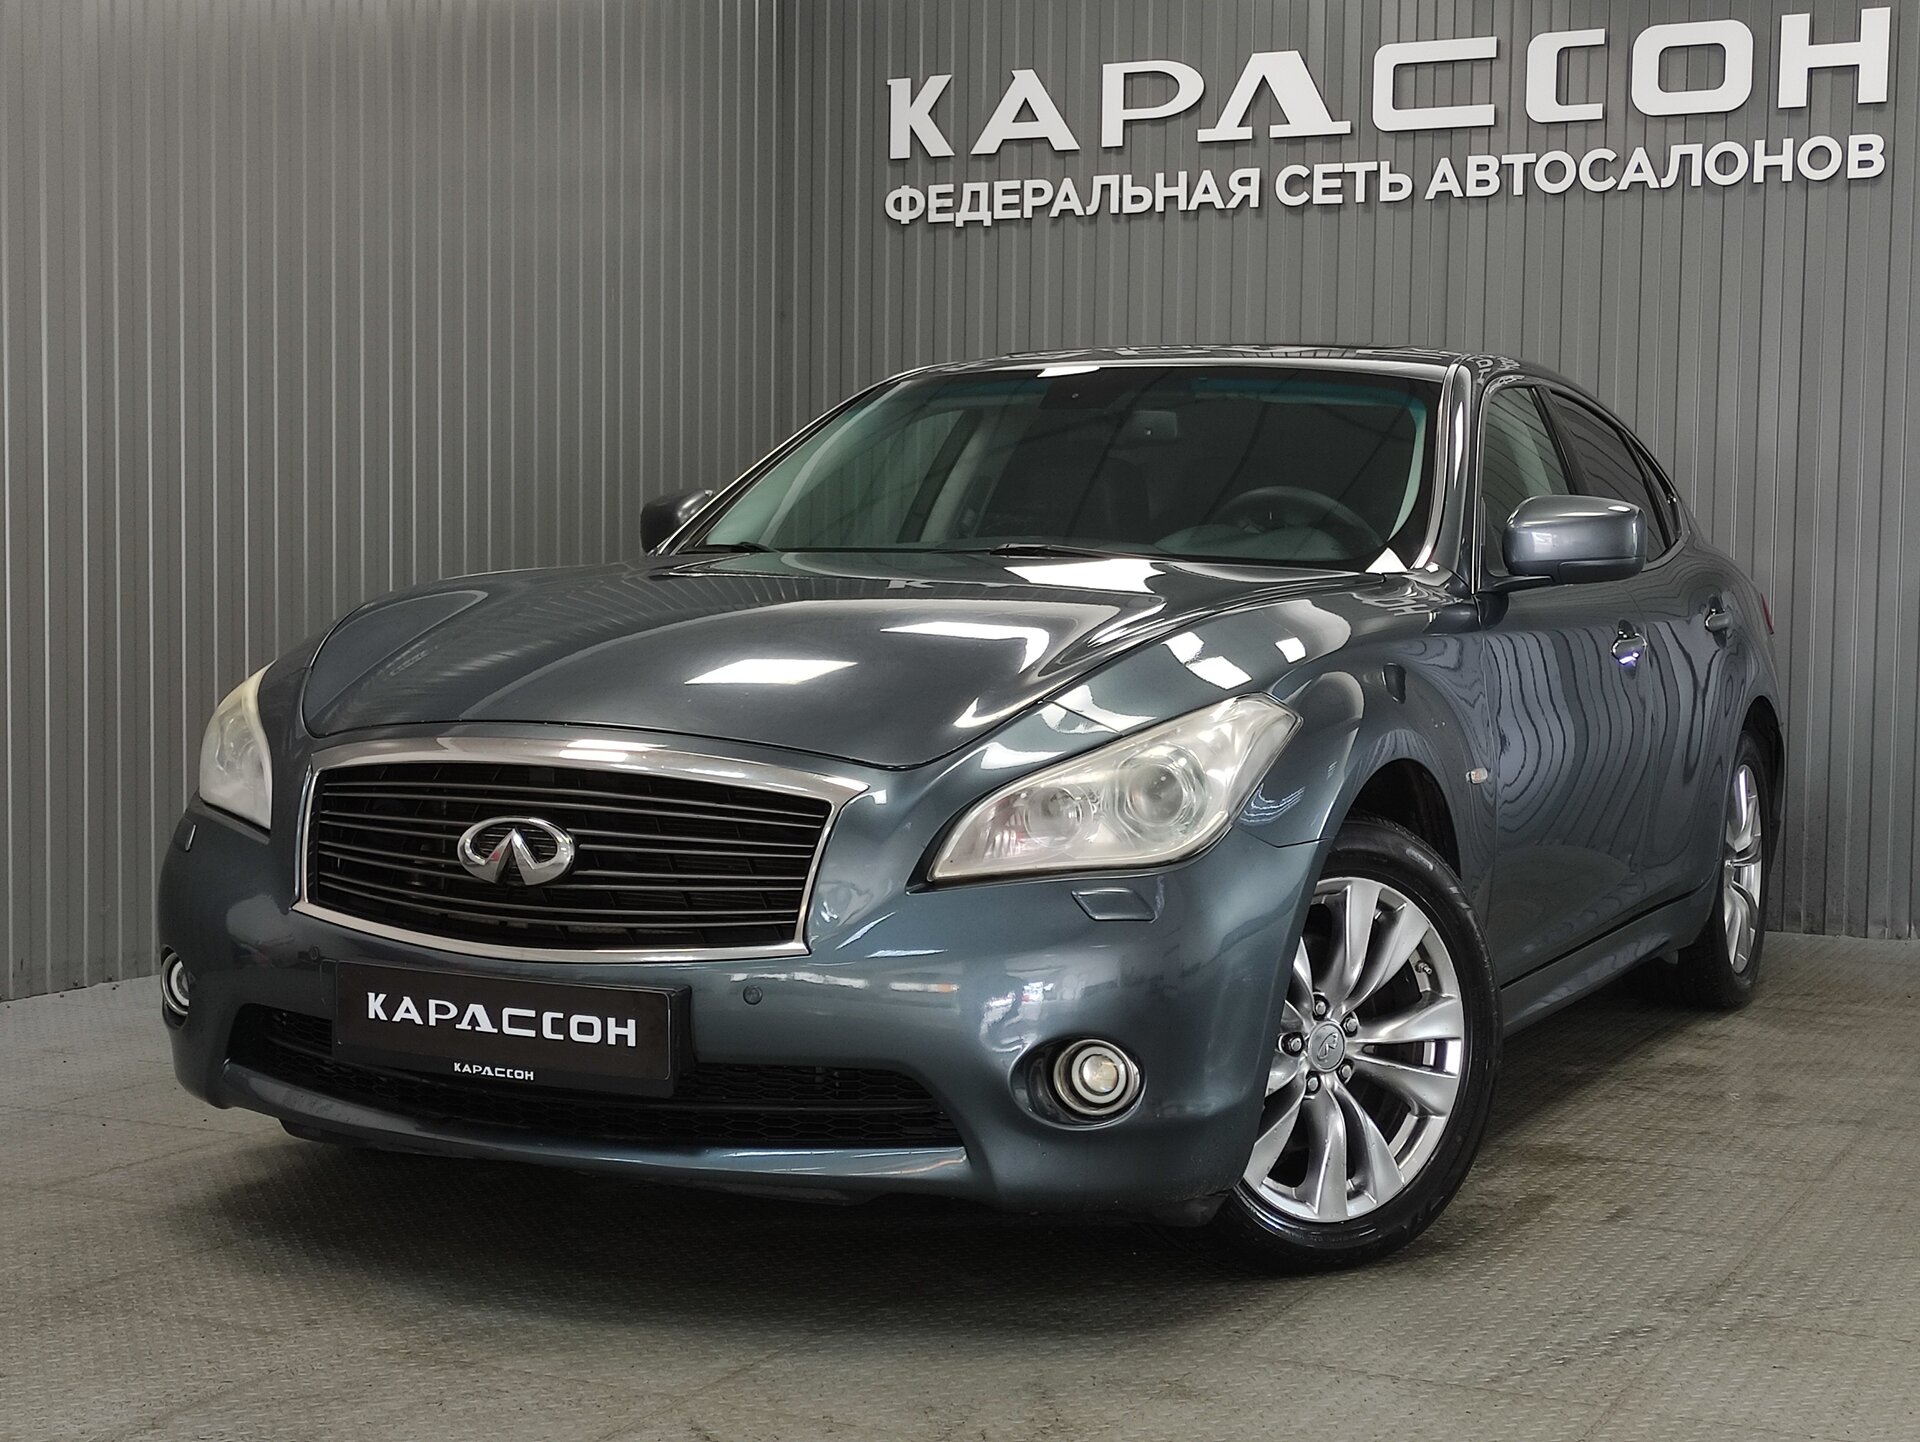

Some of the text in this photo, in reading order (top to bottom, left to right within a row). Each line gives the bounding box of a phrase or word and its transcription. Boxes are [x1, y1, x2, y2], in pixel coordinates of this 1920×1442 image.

[885, 133, 1886, 227] ФЕДЕРАЛЬНАЯ СЕТЬ АВТОСАЛОНОВ
